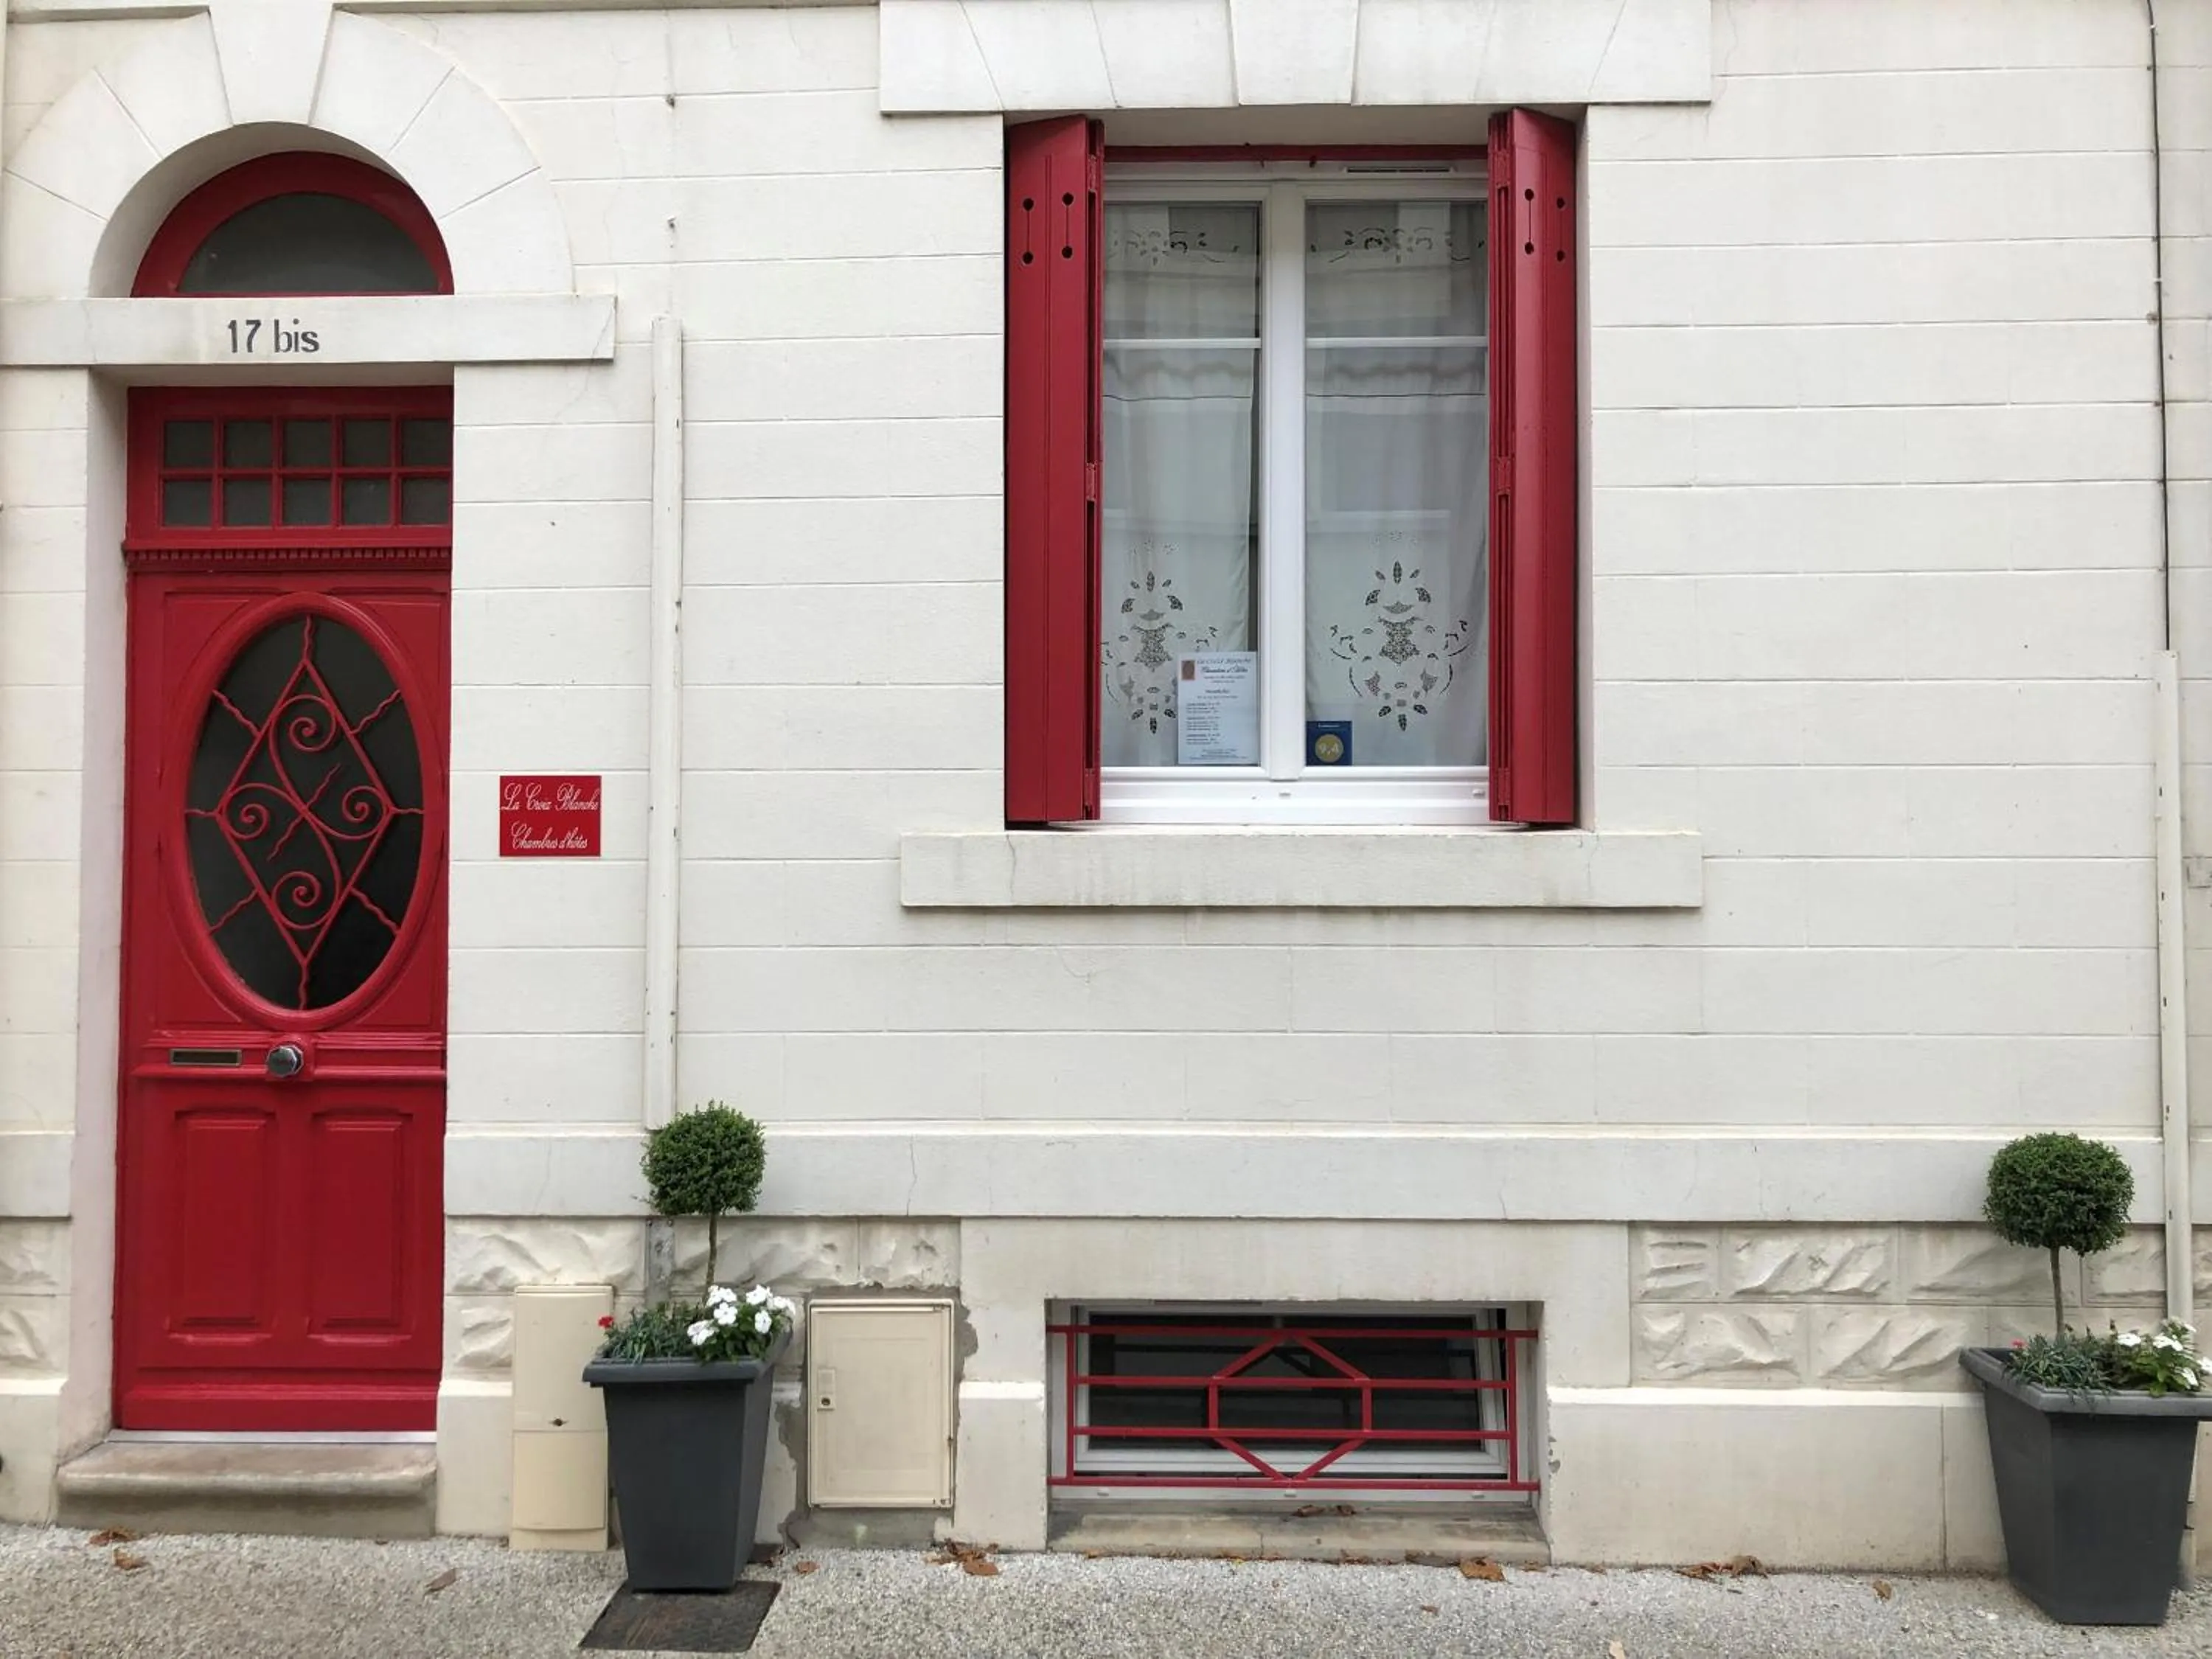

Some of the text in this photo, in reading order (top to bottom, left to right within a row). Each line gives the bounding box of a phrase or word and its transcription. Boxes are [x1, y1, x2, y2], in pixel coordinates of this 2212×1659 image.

[228, 319, 320, 353] 17 bis
[501, 782, 600, 811] La Croix Blanche
[511, 821, 558, 849] Chambres
